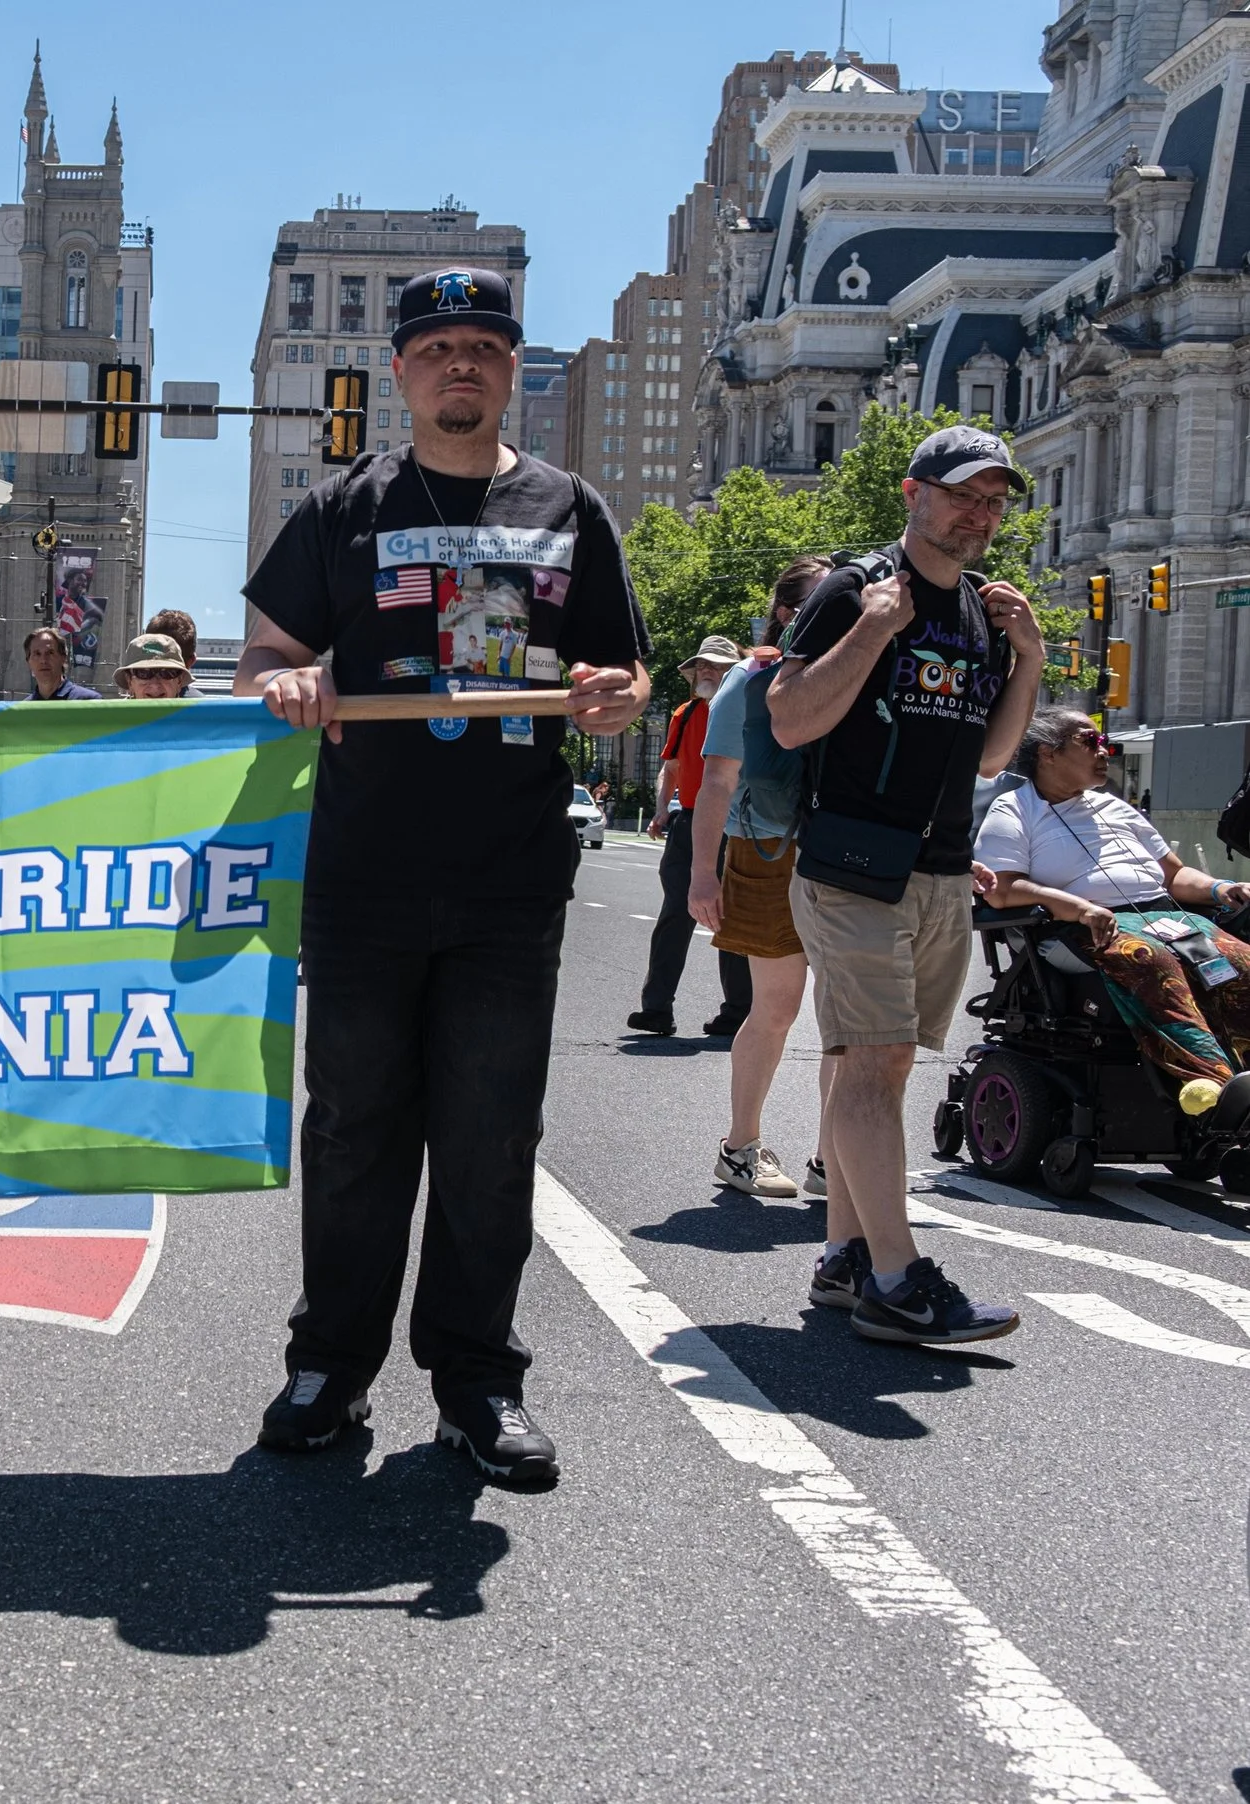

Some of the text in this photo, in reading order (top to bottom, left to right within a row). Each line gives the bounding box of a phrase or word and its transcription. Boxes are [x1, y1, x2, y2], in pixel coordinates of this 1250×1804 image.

[437, 536, 567, 552] Children's Hospital
[438, 549, 545, 562] of Philadelphia
